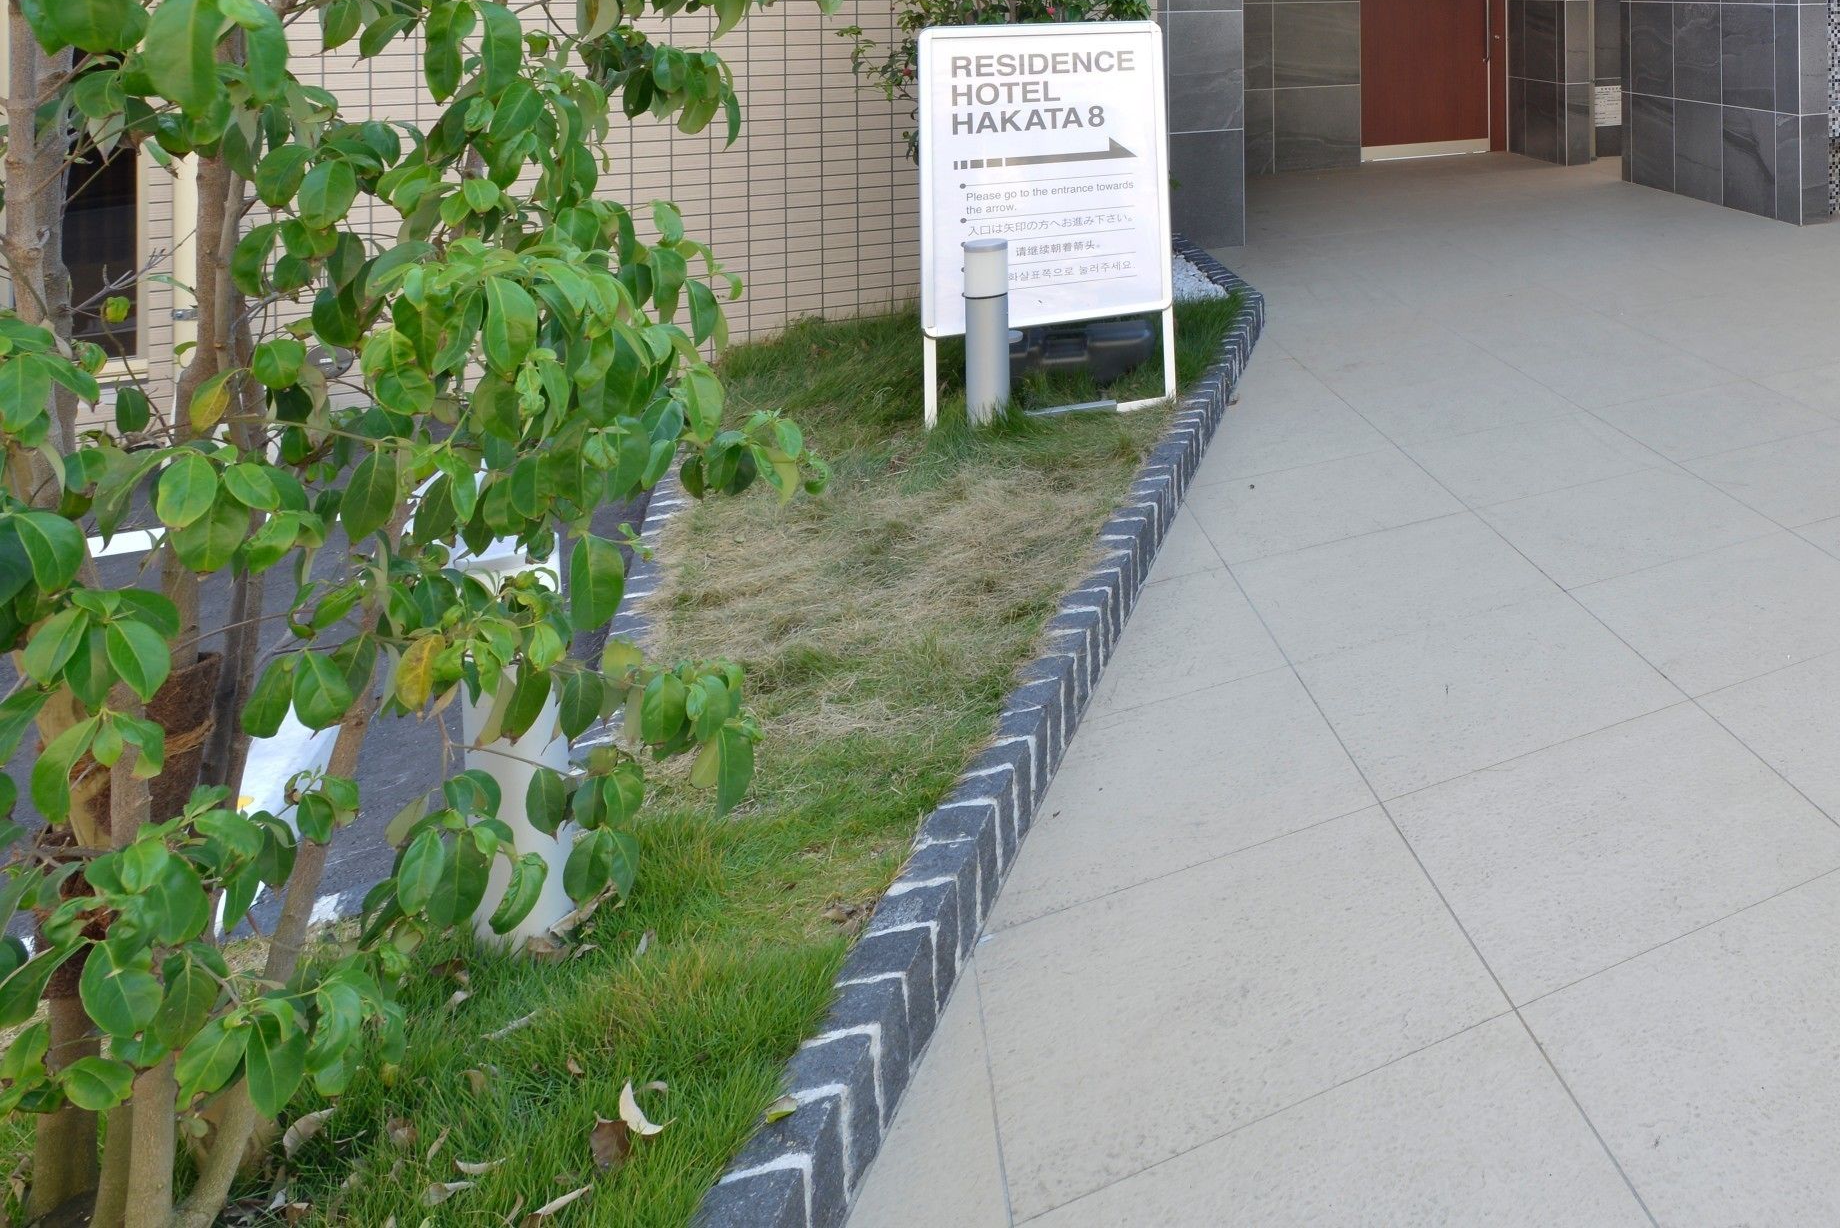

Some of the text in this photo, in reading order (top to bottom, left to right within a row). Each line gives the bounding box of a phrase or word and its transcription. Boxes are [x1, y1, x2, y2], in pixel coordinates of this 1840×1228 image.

[951, 50, 1135, 78] RESIDENCE
[951, 80, 1061, 107] HOTEL
[966, 180, 1134, 202] Please go to the entrance towards
[966, 203, 1018, 215] the arrow.
[968, 212, 1134, 237] 入口は矢印の方へお進み下さい。
